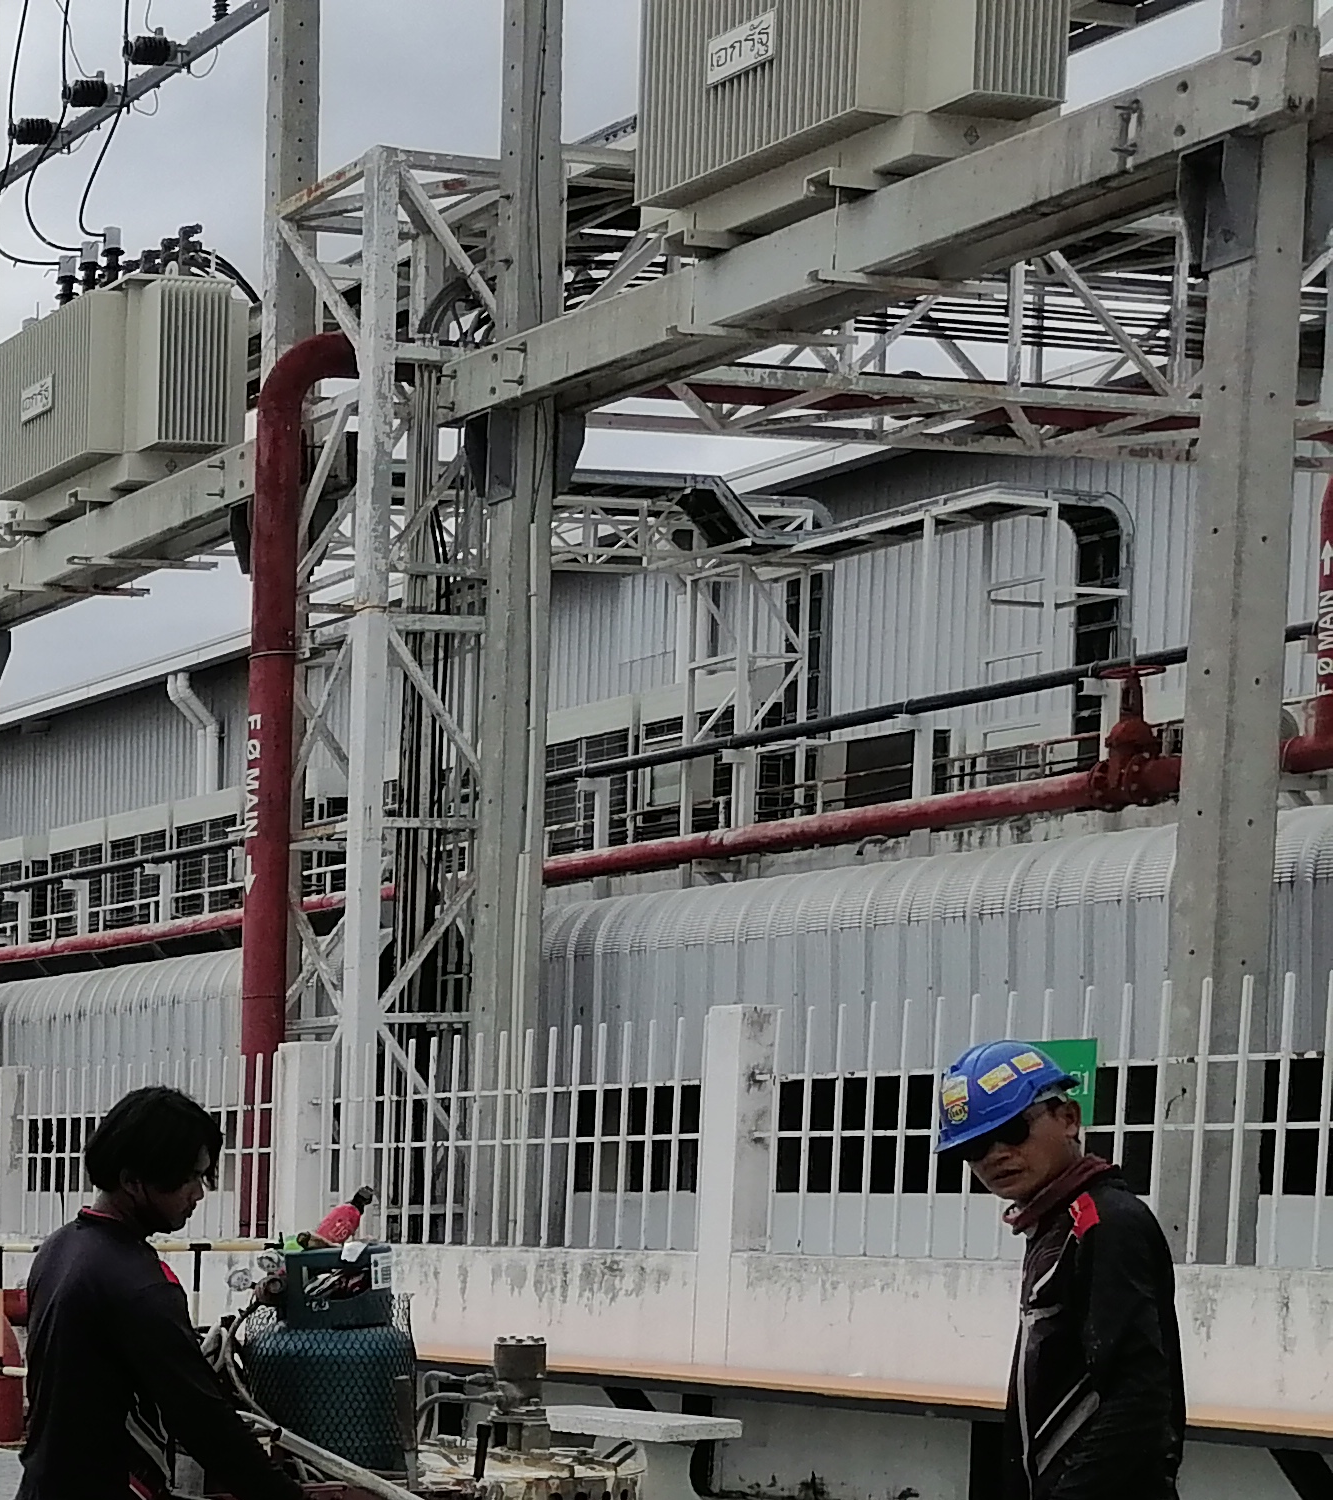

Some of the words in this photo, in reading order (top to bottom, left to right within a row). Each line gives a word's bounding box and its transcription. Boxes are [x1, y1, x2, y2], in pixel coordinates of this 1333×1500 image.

[710, 20, 771, 72] เอกรัฐ
[244, 767, 260, 838] MAIN
